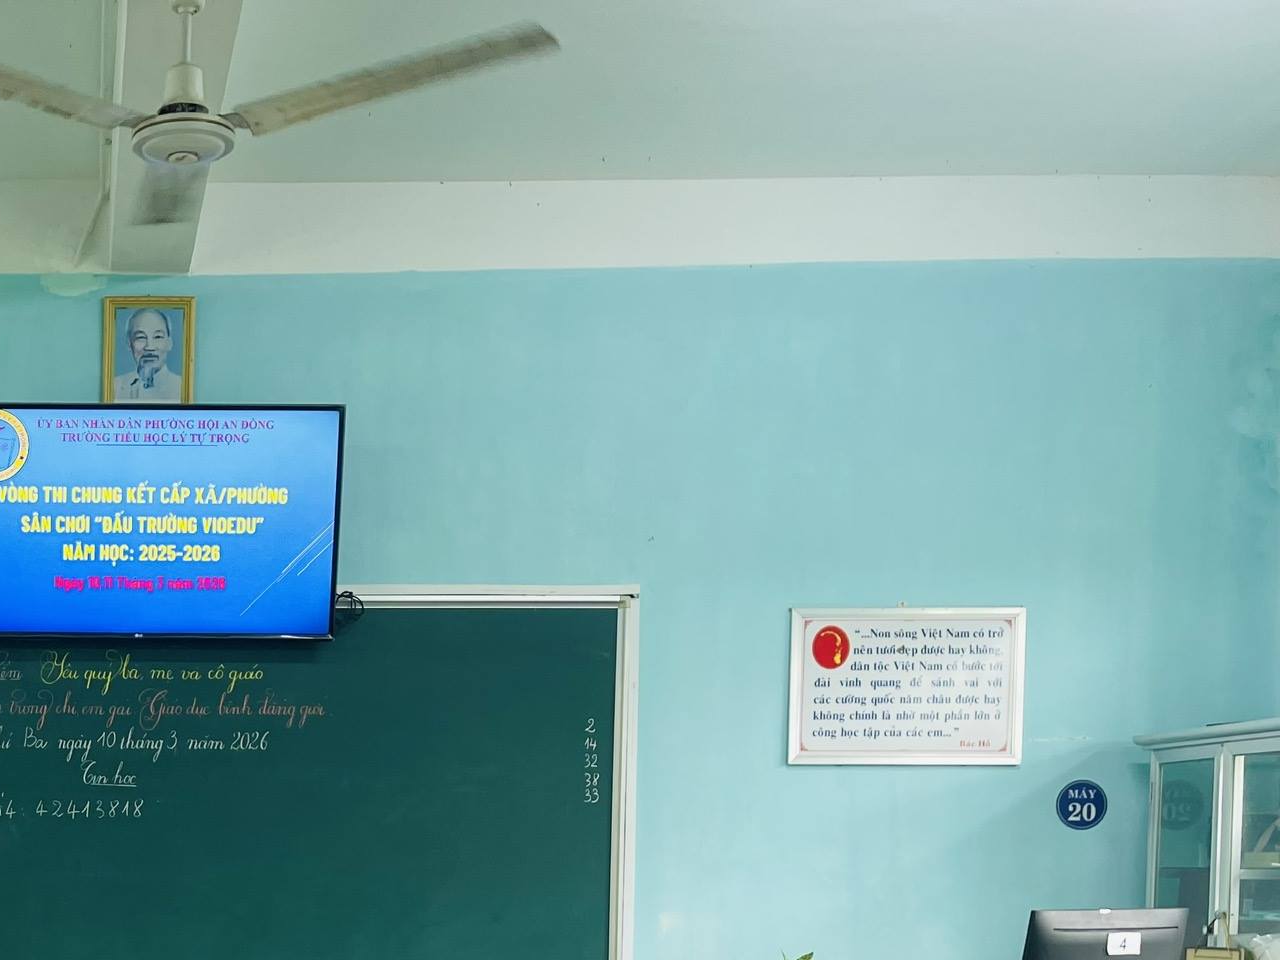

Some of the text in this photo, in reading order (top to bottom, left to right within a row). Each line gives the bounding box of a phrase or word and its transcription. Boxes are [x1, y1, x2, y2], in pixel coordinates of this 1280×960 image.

[56, 419, 79, 429] BAN
[82, 417, 114, 429] NHÂN
[117, 417, 142, 429] DÂN
[145, 417, 195, 430] PHƯỜNG
[198, 417, 220, 432] HỘI
[222, 420, 238, 430] AN
[62, 429, 250, 446] TRƯỜNG TIỂU HỌC LÝ TỰ TRỌNG
[43, 486, 67, 503] THI
[71, 486, 123, 504] CHUNG
[126, 481, 156, 504] KẾT
[160, 481, 191, 504] CẤP
[194, 483, 289, 505] XÃ/PHƯỜNG
[20, 510, 265, 535] SÂN CHƠI “ĐẤU TRƯỜNG VIOEDU”
[62, 540, 221, 567] NĂM HỌC: 2025-2026
[53, 576, 84, 592] Ngày
[117, 576, 154, 593] Tháng
[167, 577, 194, 590] năm
[894, 629, 918, 640] sông
[920, 628, 943, 640] Việt
[946, 628, 970, 639] Nam
[973, 629, 985, 639] có
[988, 628, 1004, 639] trở
[853, 644, 873, 655] nên
[876, 644, 896, 655] tươi
[898, 644, 918, 657] đẹp
[920, 644, 945, 656] được
[948, 644, 966, 657] hay
[850, 660, 1004, 673] dân tộc Việt Nam có bước tới
[207, 663, 225, 680] cô
[228, 664, 264, 694] giáo
[814, 675, 1003, 690] đài vinh quang để sánh vai với
[813, 692, 1001, 706] các cường quốc năm châu được hay
[812, 709, 1001, 723] không chính là nhờ một phần lớn ở
[585, 718, 596, 733] 2
[812, 727, 837, 740] công
[840, 726, 859, 740] học
[863, 727, 880, 740] tập
[884, 725, 902, 737] của
[906, 727, 924, 737] các
[23, 726, 48, 748] Ba
[58, 734, 93, 762] ngày
[96, 731, 117, 748] 10
[120, 726, 164, 763] tháng
[167, 730, 178, 750] 3
[188, 735, 225, 750] năm
[230, 731, 270, 750] 2026
[584, 737, 597, 751] 14
[584, 753, 598, 768] 32
[584, 772, 600, 787] 38
[584, 788, 600, 803] 33
[1068, 786, 1097, 799] MÁY
[1068, 802, 1097, 822] 20
[1119, 938, 1127, 951] 4
